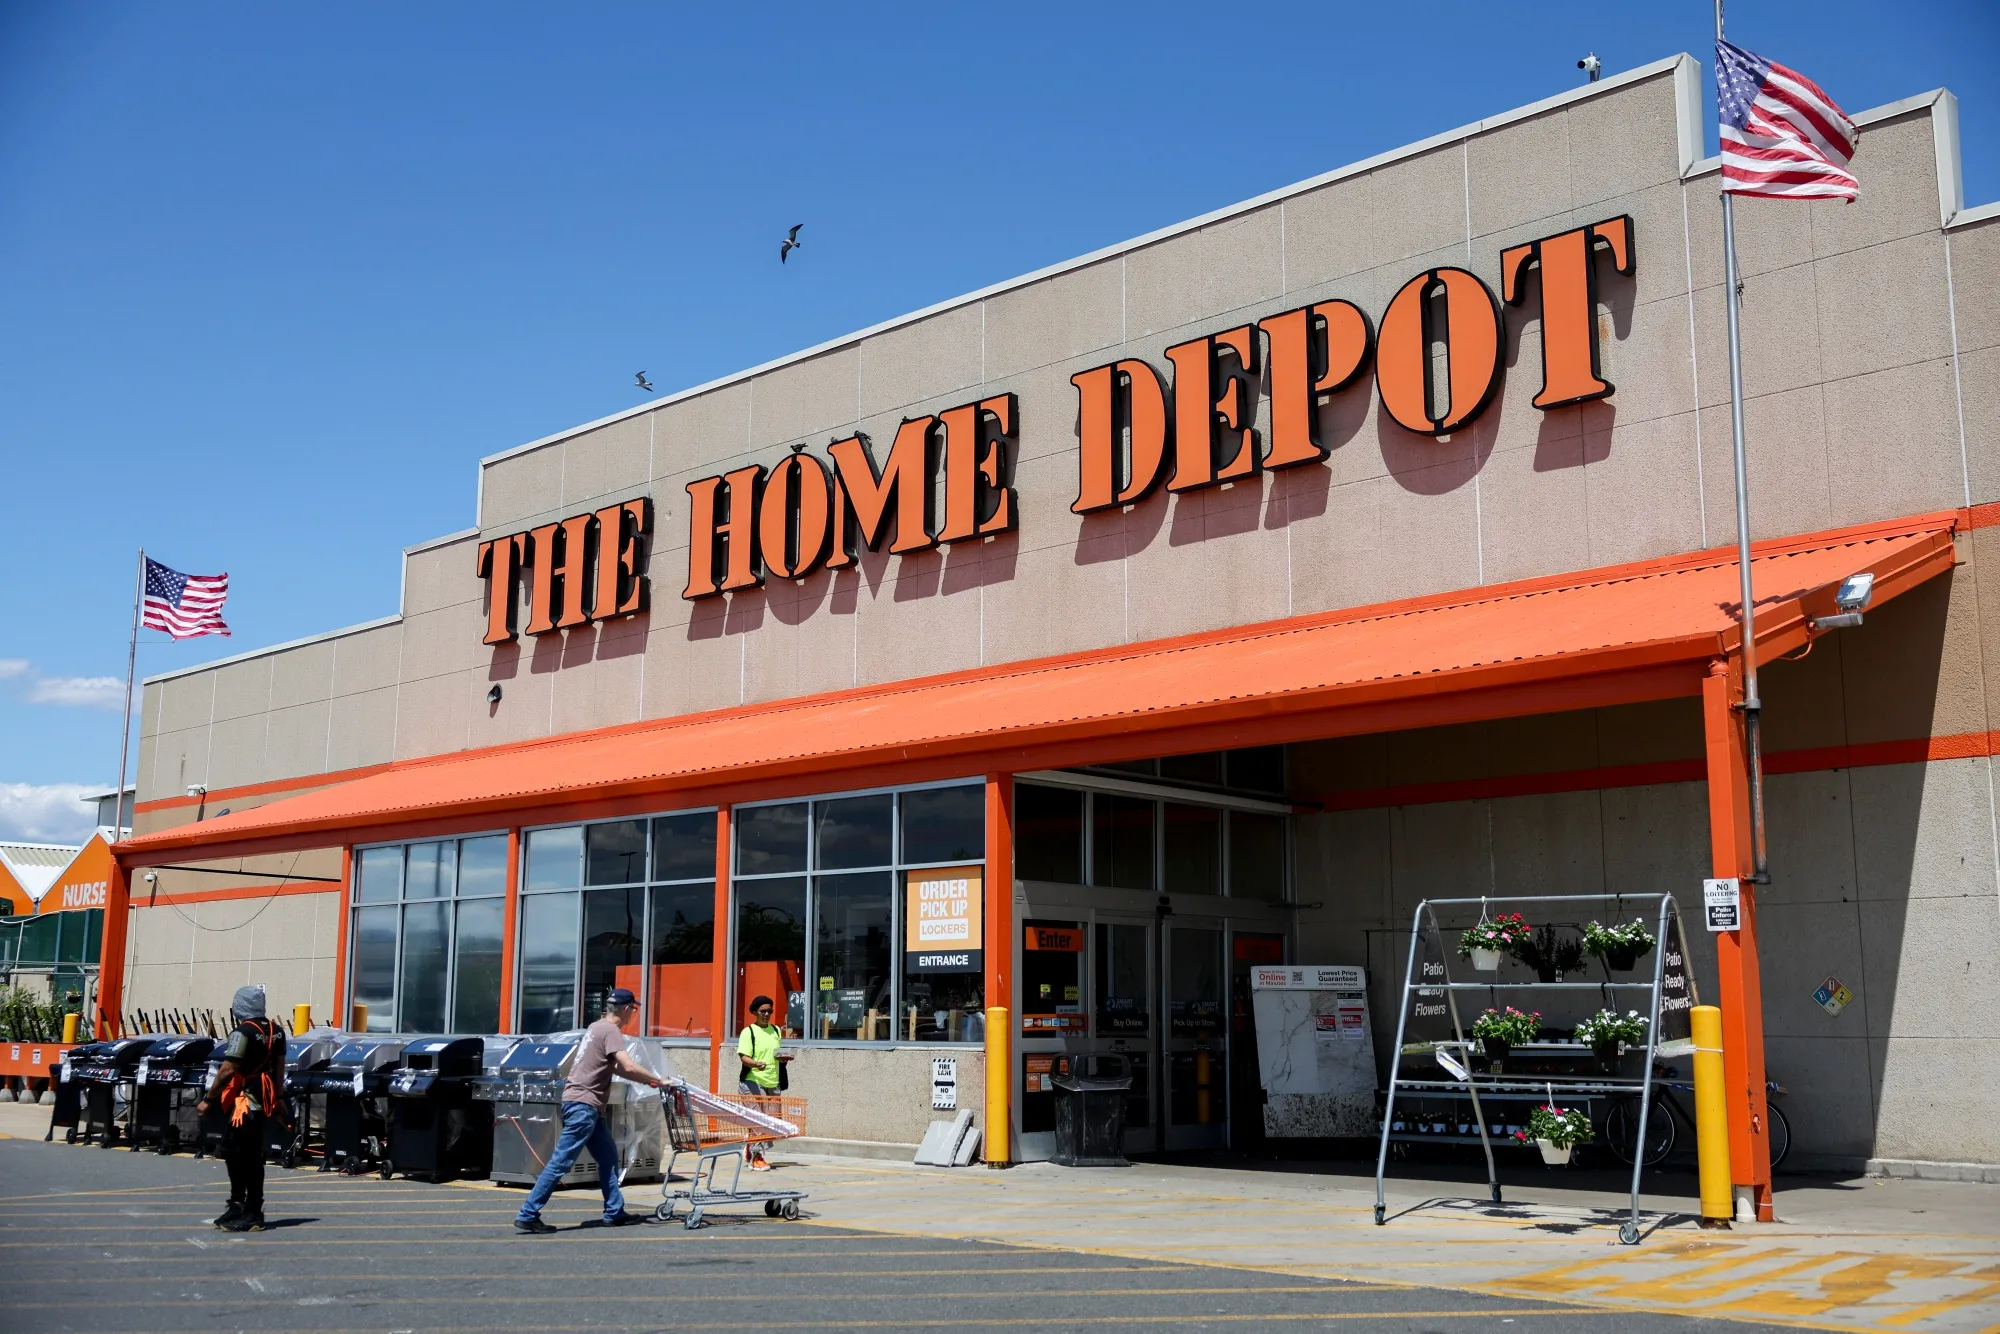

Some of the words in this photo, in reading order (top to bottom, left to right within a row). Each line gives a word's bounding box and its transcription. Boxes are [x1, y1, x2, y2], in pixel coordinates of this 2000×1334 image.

[477, 496, 654, 646] THE
[681, 394, 1019, 601] HOME
[1070, 213, 1636, 516] DEPOT
[919, 879, 968, 900] ORDER
[1716, 883, 1729, 891] NO
[920, 900, 948, 918] PICK
[951, 900, 968, 917] UP
[921, 923, 967, 936] LOCKERS
[1038, 930, 1072, 949] Enter
[919, 954, 969, 967] ENTRANCE
[1665, 952, 1682, 967] Patio
[1423, 962, 1444, 976] Patio
[1664, 972, 1685, 990] Ready
[1417, 982, 1444, 998] ady
[1819, 991, 1826, 1001] 3
[1839, 991, 1845, 1000] 2
[1415, 1003, 1446, 1016] Flowers
[1664, 996, 1689, 1011] Flowers
[1113, 1019, 1124, 1028] Buy
[1186, 1019, 1194, 1027] Up
